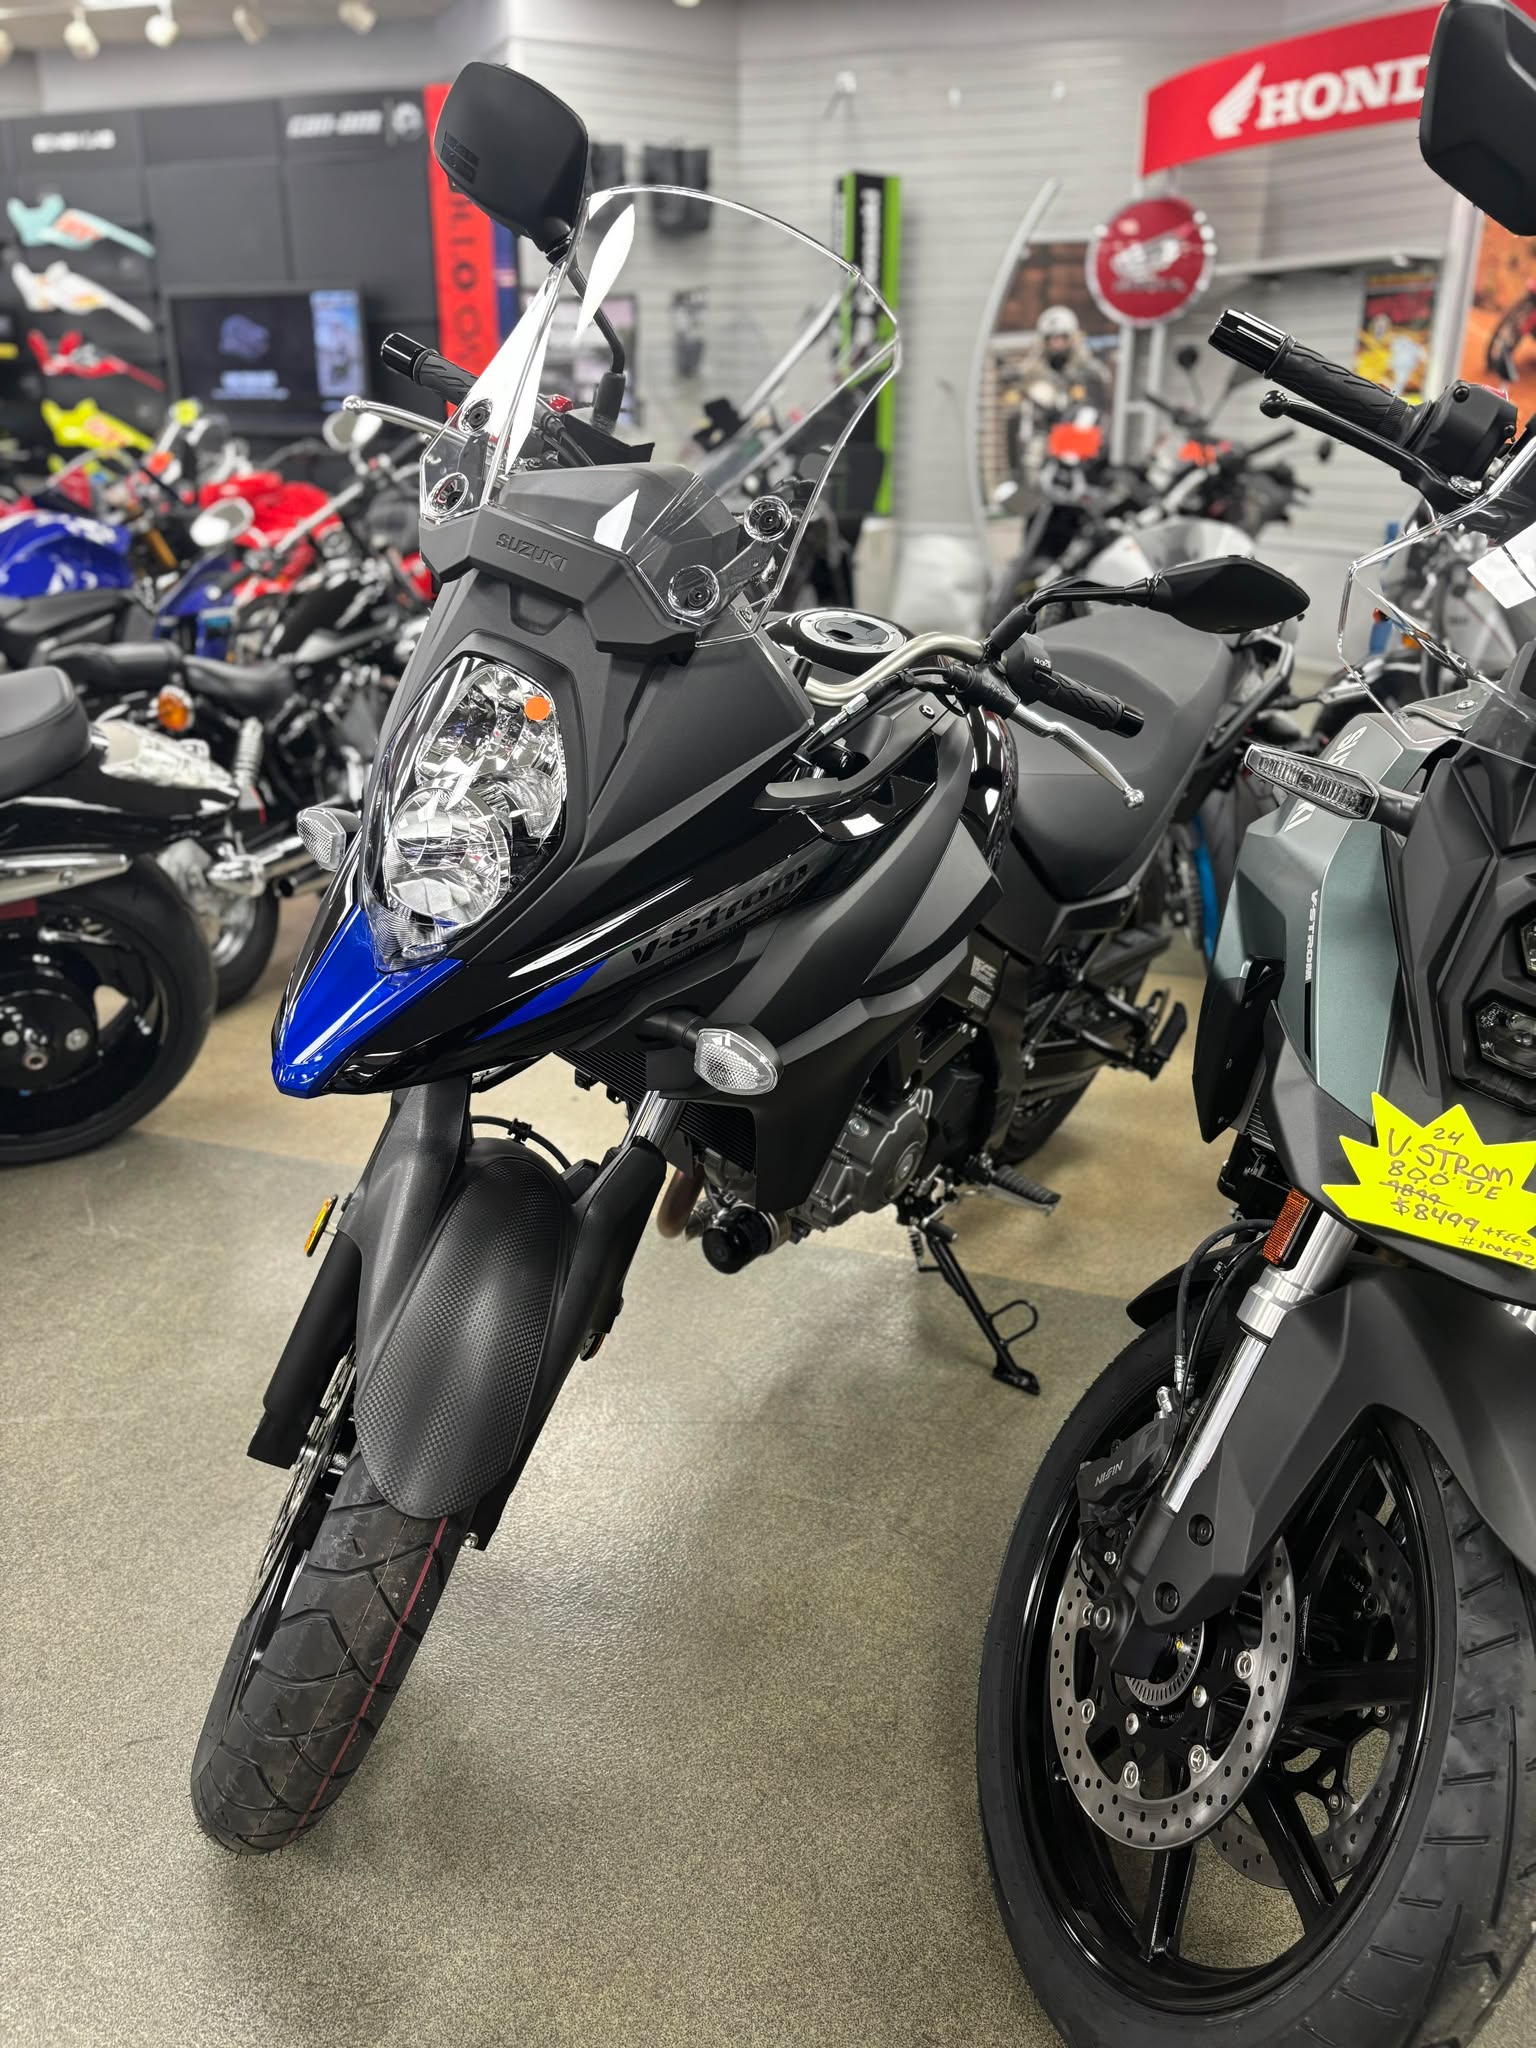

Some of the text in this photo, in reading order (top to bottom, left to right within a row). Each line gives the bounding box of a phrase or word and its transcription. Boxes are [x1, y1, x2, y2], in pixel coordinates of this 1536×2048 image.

[495, 533, 568, 572] SUZUKI
[1284, 726, 1368, 832] SUKI
[1433, 1127, 1465, 1146] 24
[1387, 1159, 1503, 1201] 800 DE
[1390, 1196, 1481, 1233] $8499
[1094, 1459, 1124, 1488] NISSIN
